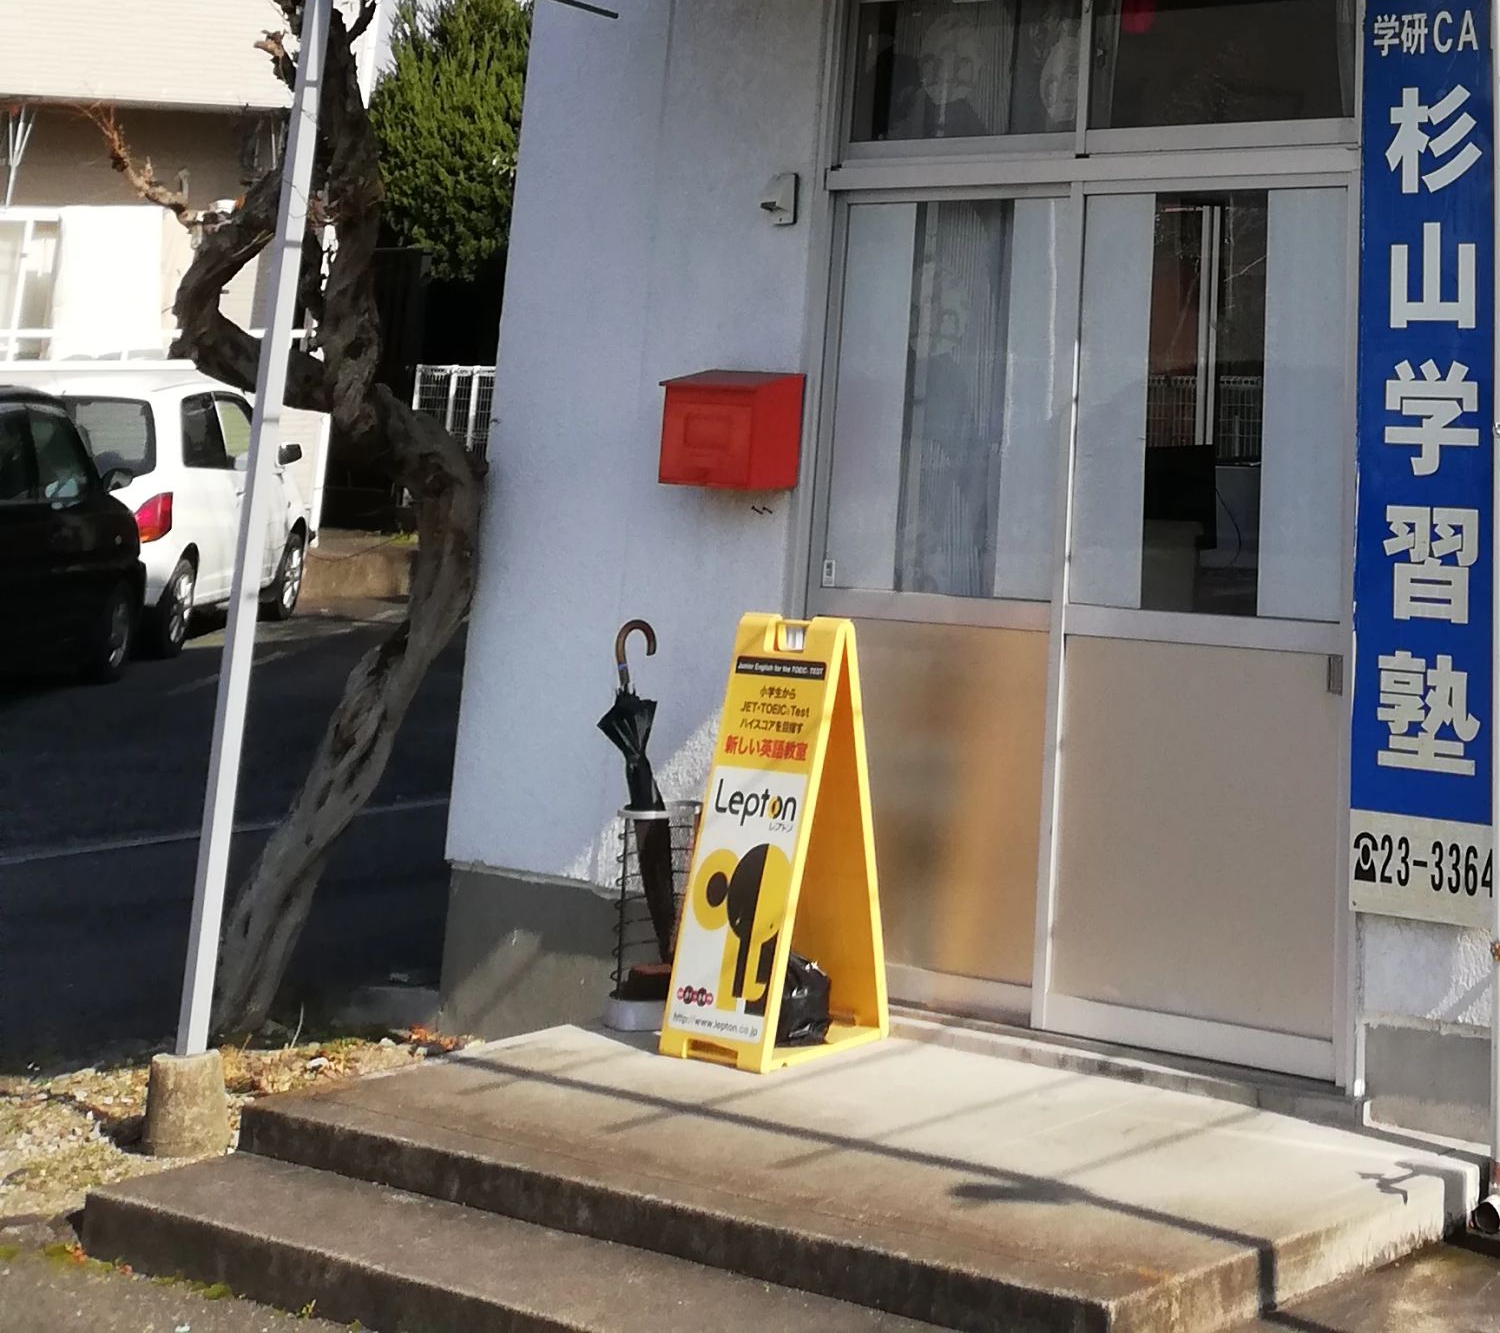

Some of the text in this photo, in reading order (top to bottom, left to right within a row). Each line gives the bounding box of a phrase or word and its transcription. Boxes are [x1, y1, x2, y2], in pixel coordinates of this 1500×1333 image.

[1376, 83, 1483, 777] 杉山学習塾
[754, 662, 774, 672] English
[759, 685, 796, 700] 小学生から
[724, 732, 808, 761] 新しい英語教室
[714, 778, 797, 827] Lepton
